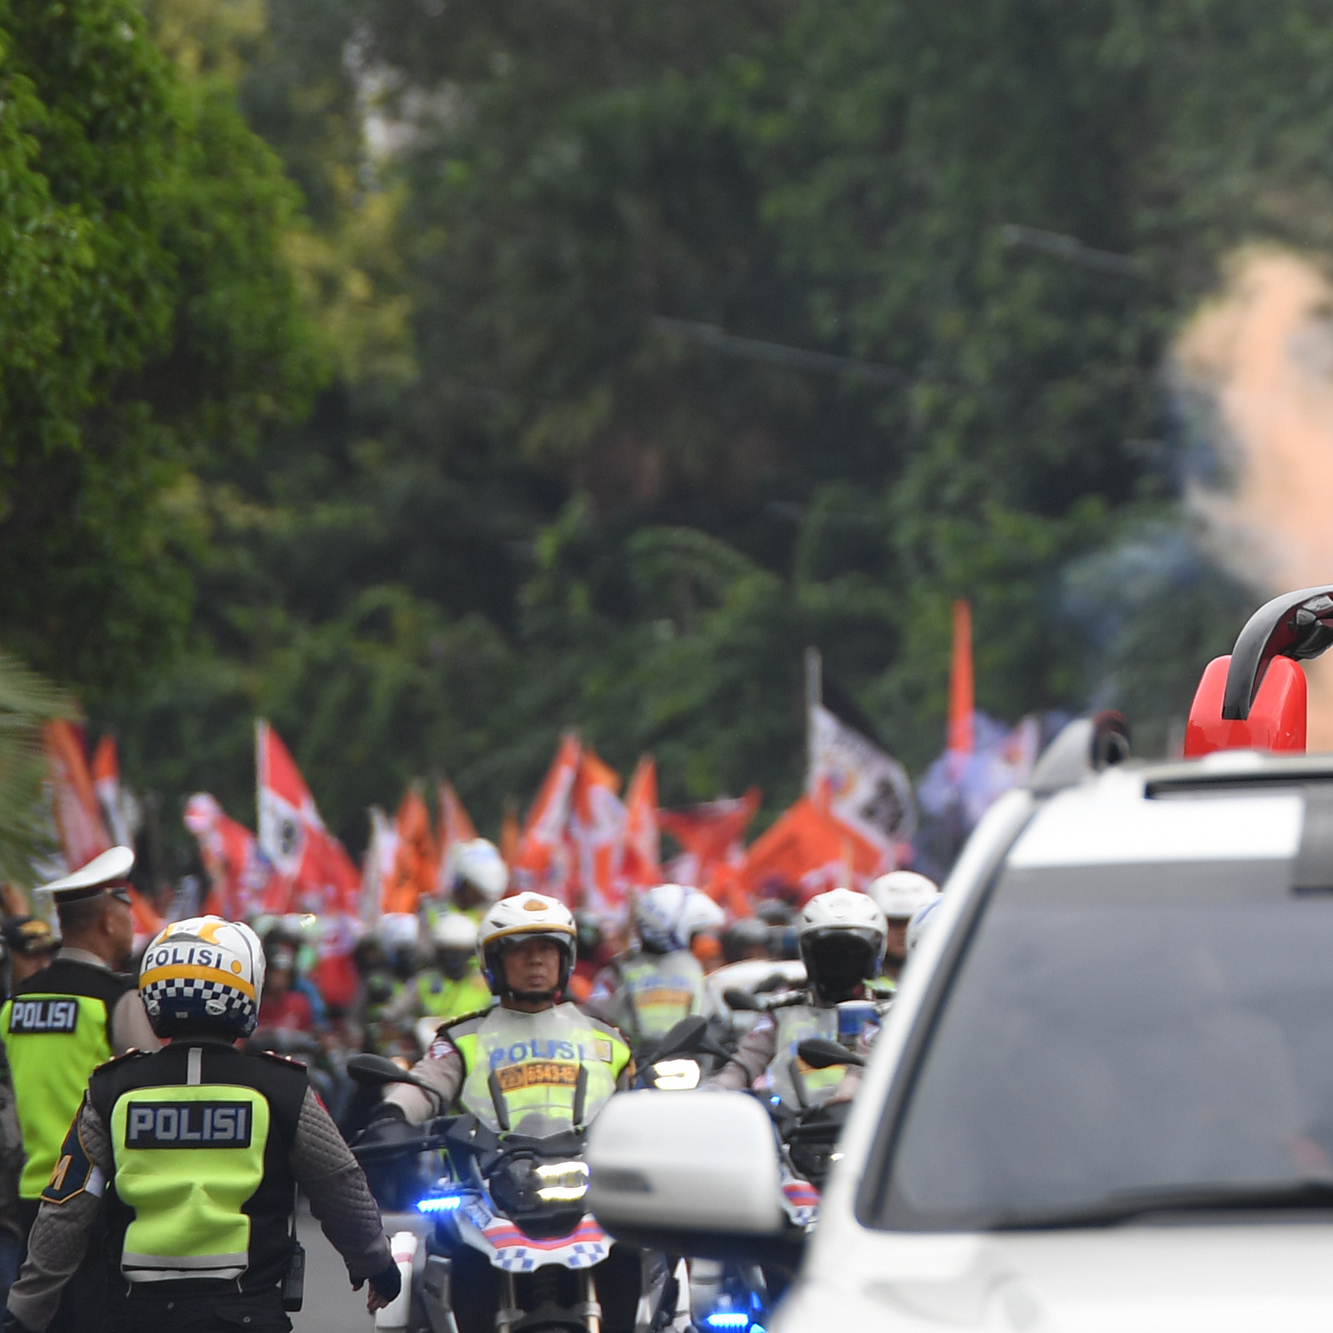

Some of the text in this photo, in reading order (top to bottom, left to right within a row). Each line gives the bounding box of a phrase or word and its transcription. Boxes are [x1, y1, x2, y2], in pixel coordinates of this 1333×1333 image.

[145, 947, 223, 970] POLISI
[10, 1001, 76, 1029] POLISI
[488, 1038, 585, 1070] POLISI
[128, 1106, 247, 1142] POLISI
